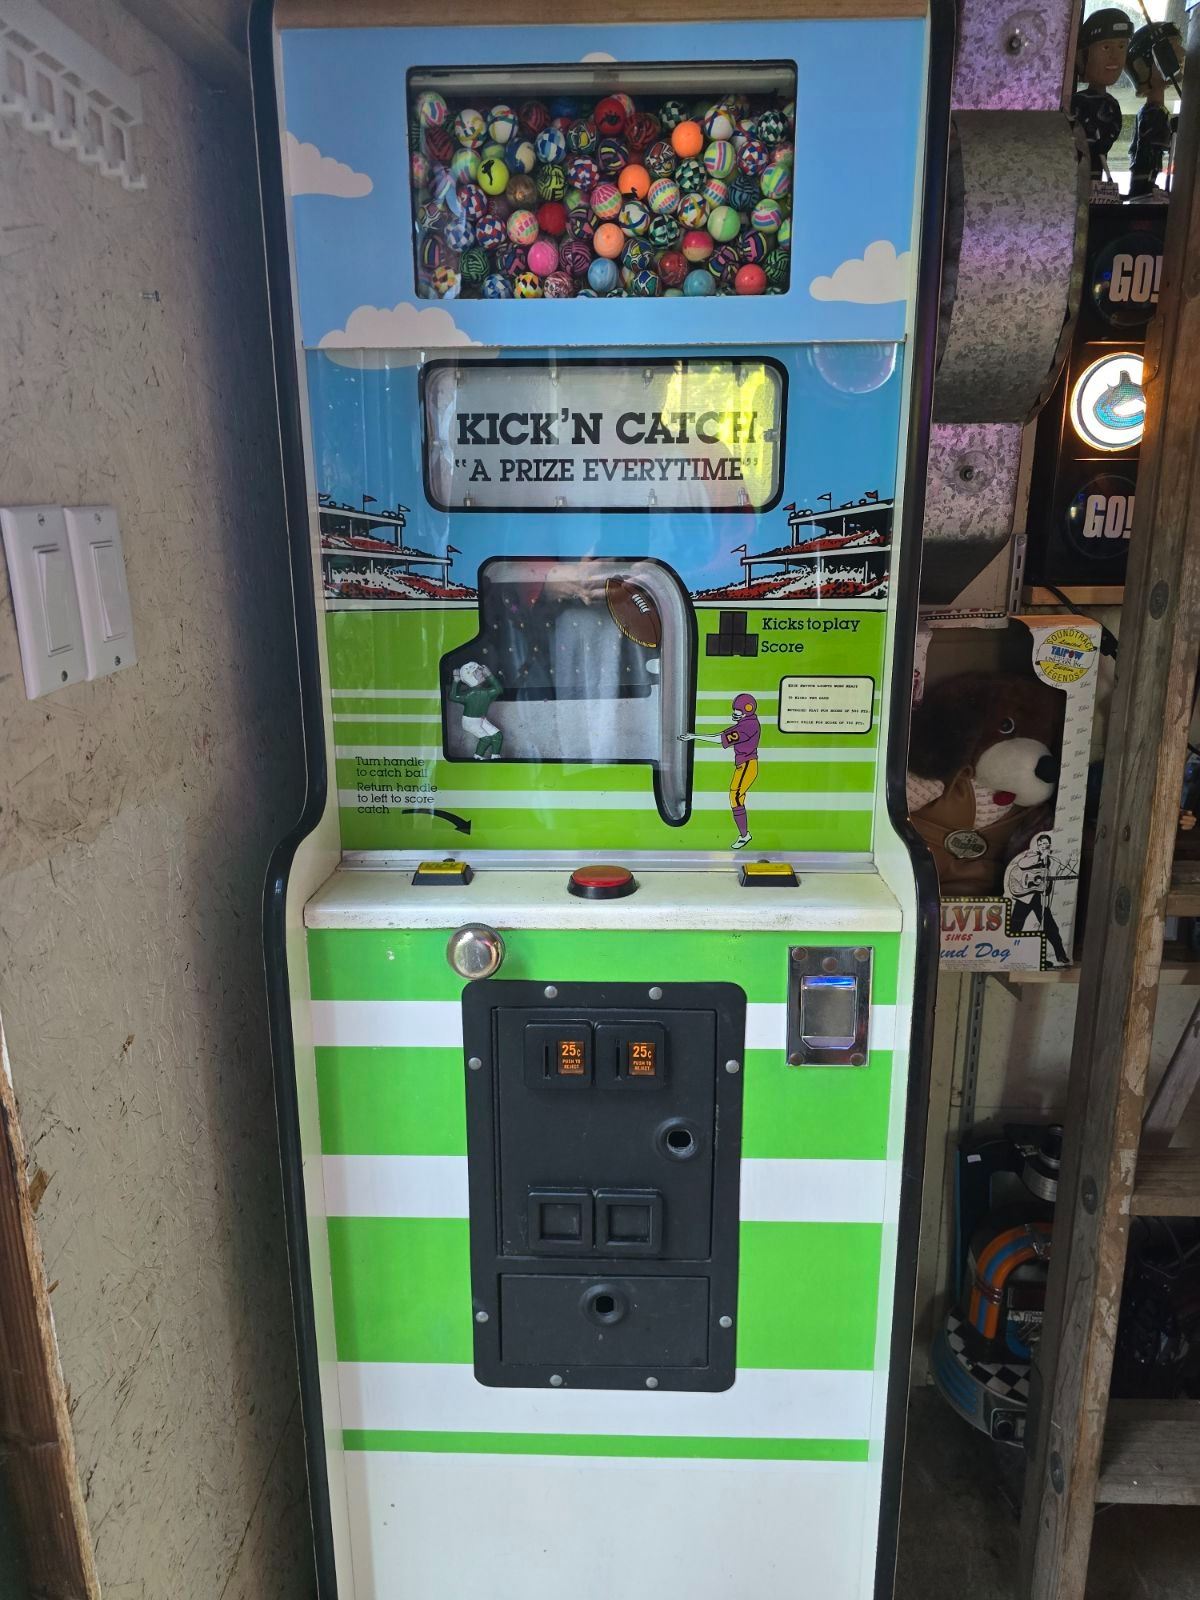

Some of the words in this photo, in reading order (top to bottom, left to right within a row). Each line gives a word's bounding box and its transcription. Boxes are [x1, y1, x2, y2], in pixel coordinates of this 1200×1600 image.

[1109, 254, 1163, 303] GO!
[457, 407, 603, 445] KICK'N
[615, 411, 757, 444] CATCH
[499, 459, 575, 482] PRIZE
[1083, 495, 1135, 538] GO!
[762, 618, 804, 630] Kicks
[807, 618, 821, 630] to
[822, 618, 860, 633] play
[761, 641, 804, 653] Score
[1044, 666, 1079, 682] LEGENDS
[726, 731, 739, 742] 2
[355, 756, 383, 766] Turn
[384, 757, 425, 767] handle
[356, 768, 367, 777] to
[369, 768, 402, 777] catch
[405, 768, 428, 778] ball
[357, 782, 393, 791] Return
[396, 782, 438, 792] handle
[357, 794, 368, 803] to
[371, 794, 388, 803] left
[391, 794, 402, 803] to
[404, 796, 434, 804] score
[357, 805, 390, 814] catch
[940, 905, 1003, 932] LVIS
[945, 933, 973, 941] SINGS
[940, 945, 969, 958] und
